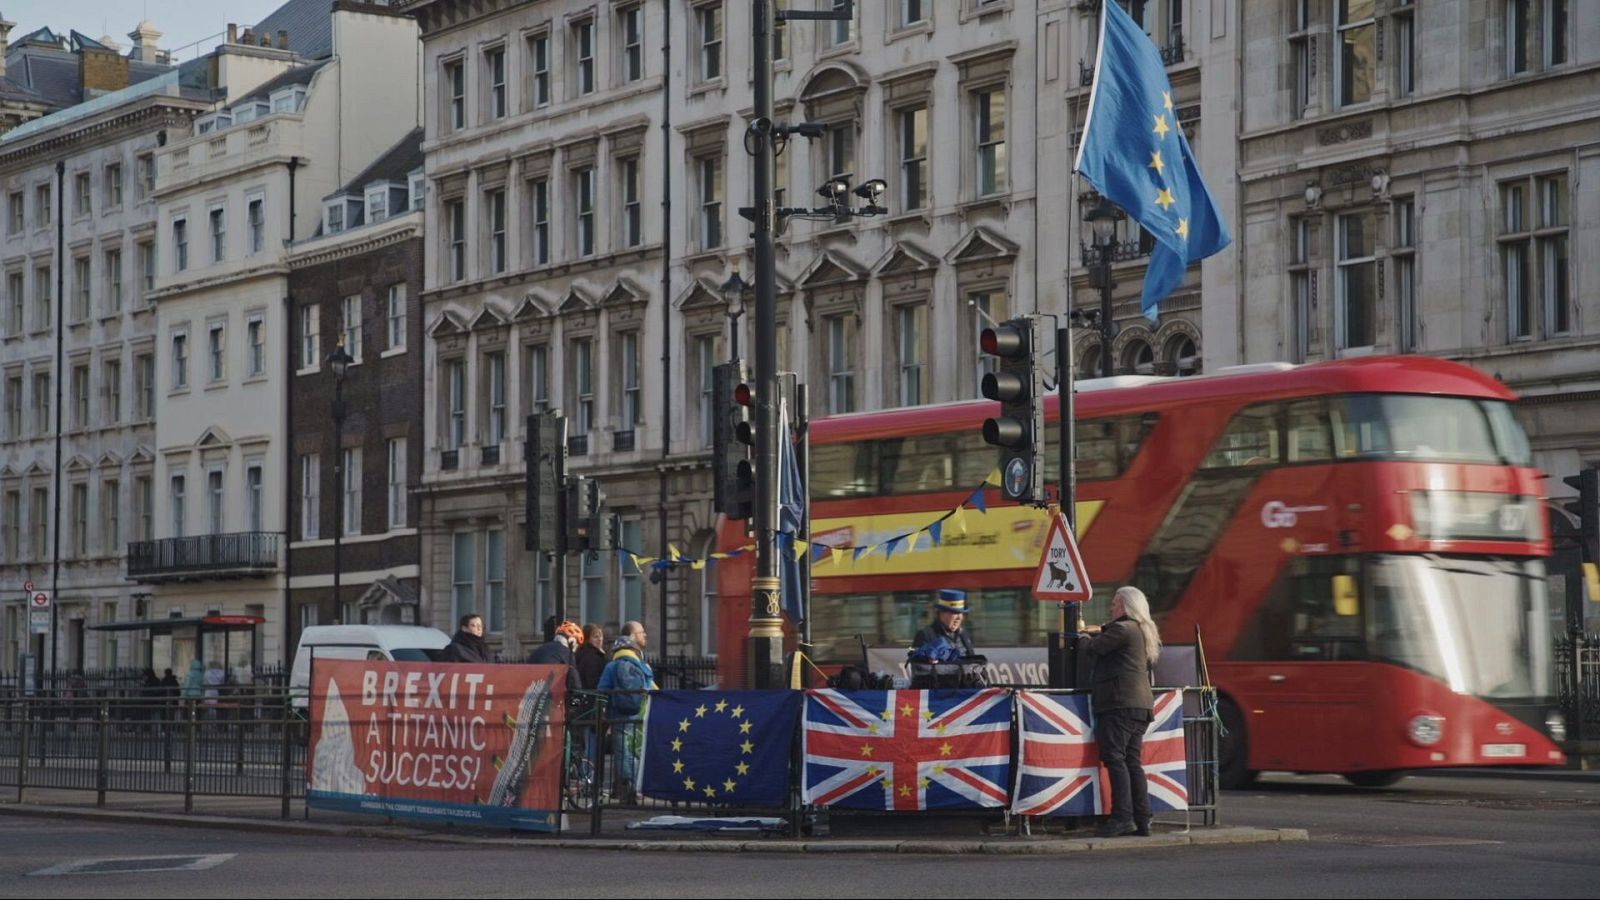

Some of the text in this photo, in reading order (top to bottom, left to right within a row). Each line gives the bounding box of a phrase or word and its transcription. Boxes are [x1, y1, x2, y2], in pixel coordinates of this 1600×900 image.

[1050, 547, 1066, 558] TORY
[362, 670, 494, 711] BREXIT:
[366, 711, 486, 751] A TITANIC
[365, 750, 481, 790] SUCCESS!
